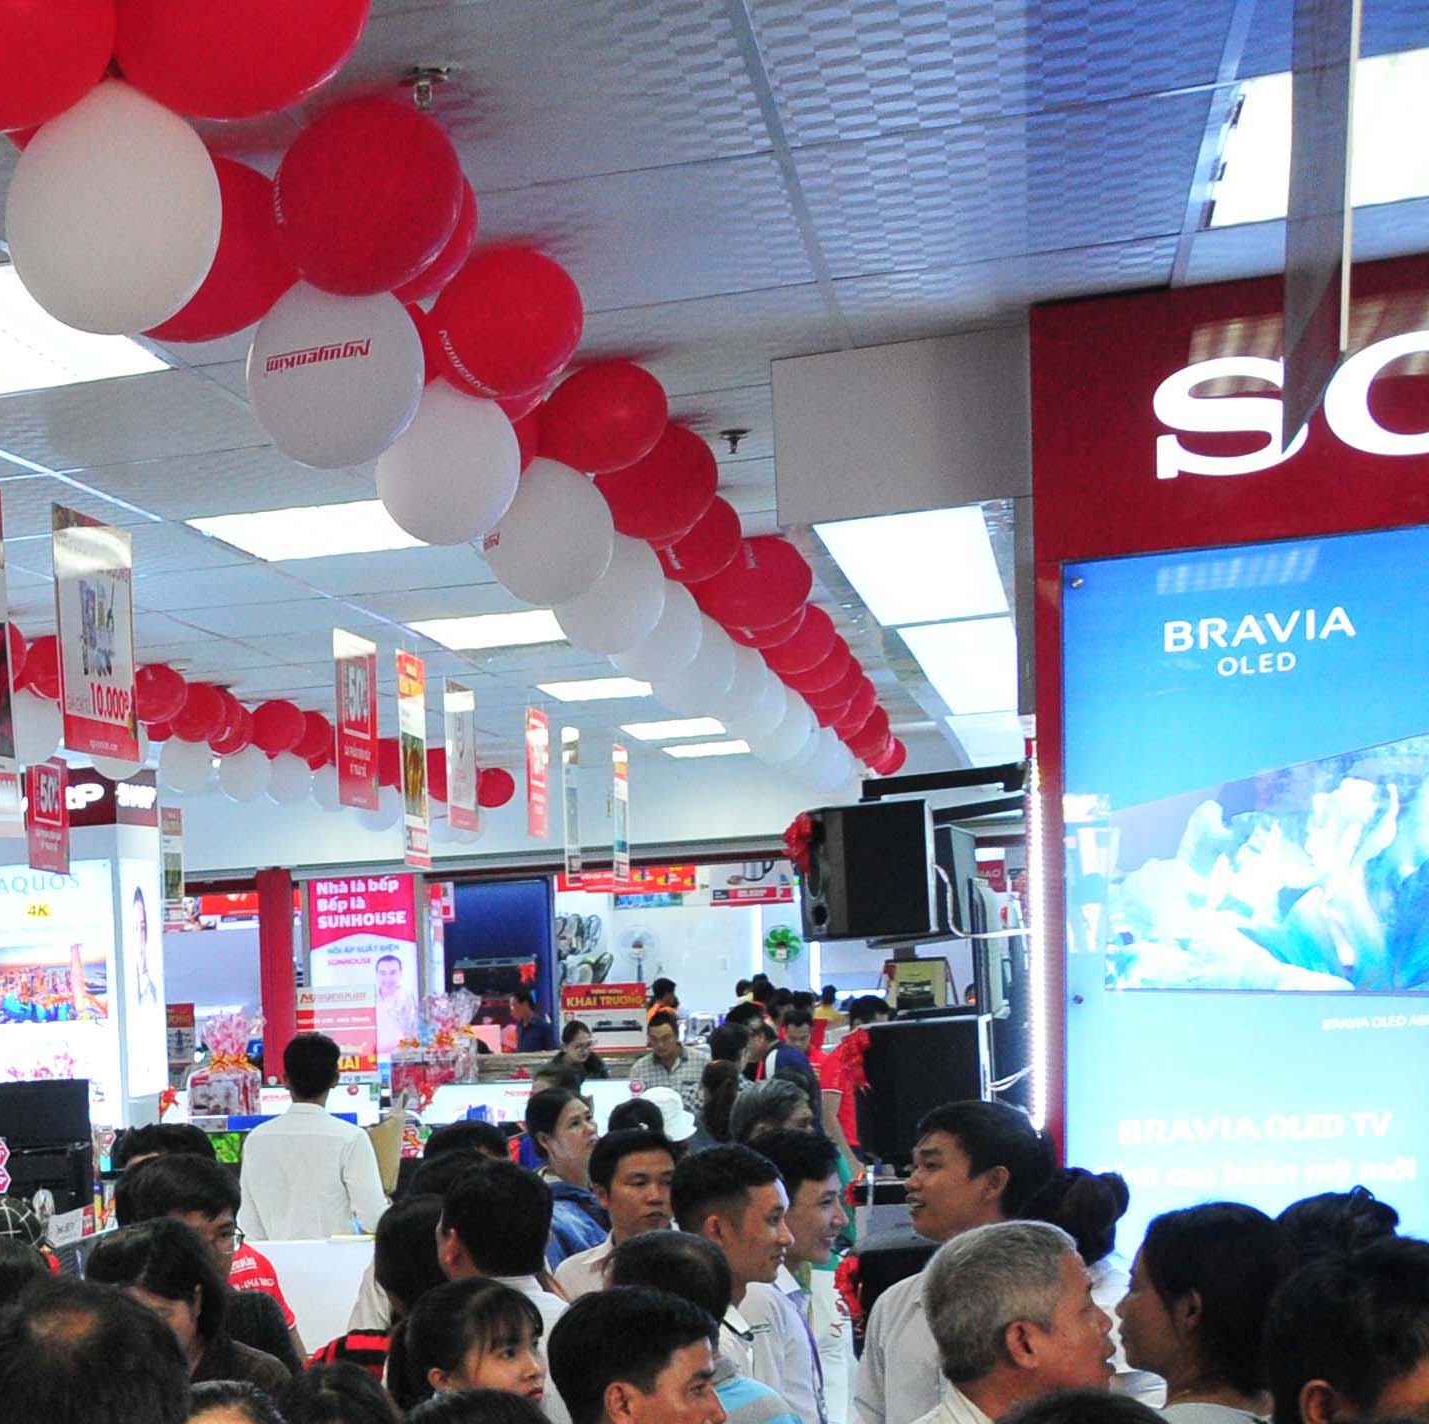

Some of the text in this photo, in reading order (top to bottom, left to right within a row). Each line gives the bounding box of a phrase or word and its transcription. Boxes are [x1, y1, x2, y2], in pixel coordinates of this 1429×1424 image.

[1163, 606, 1356, 653] BRAVIA
[1217, 652, 1297, 677] OLED
[316, 876, 399, 896] Nhà là bếp
[27, 905, 50, 917] 4K
[317, 896, 365, 913] Bếp là
[318, 911, 407, 929] SUNHOUSE
[566, 993, 596, 1009] KHAI
[1118, 1111, 1393, 1144] BRAVIA OLED TV
